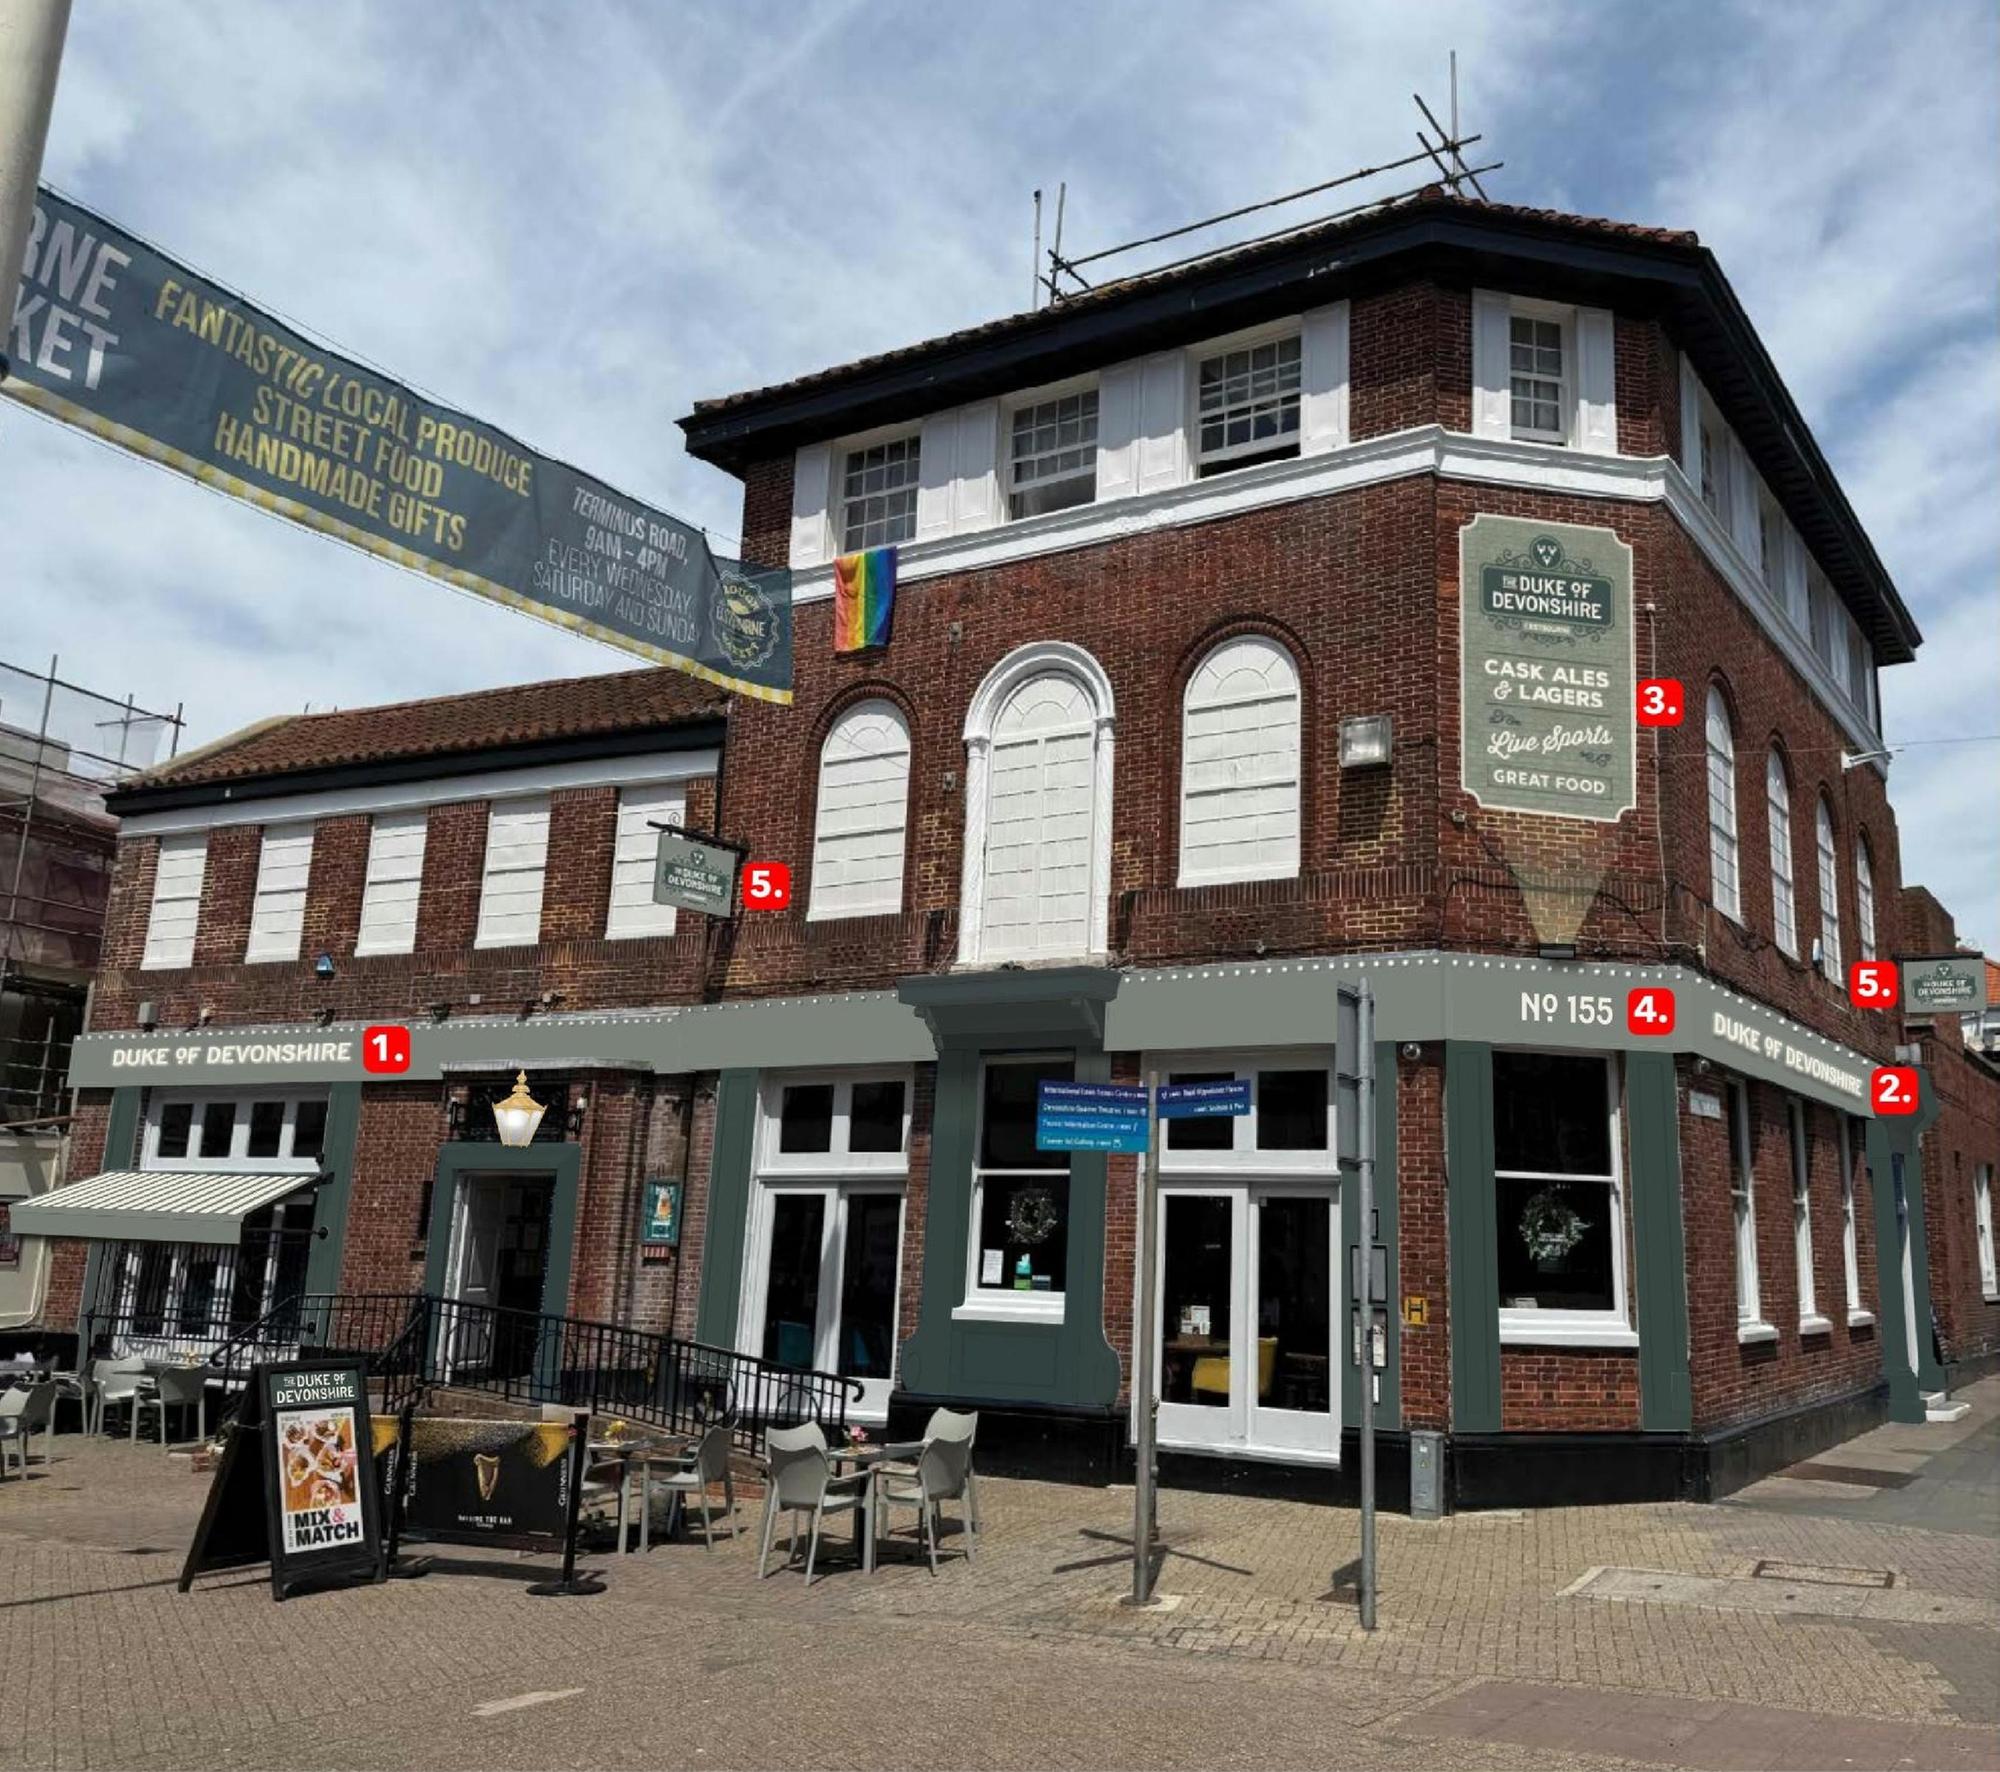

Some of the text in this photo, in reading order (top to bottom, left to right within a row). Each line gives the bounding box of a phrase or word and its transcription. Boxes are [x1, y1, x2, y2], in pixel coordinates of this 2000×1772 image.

[154, 279, 533, 498] FANTASTIC LOCAL PRODUCE
[253, 386, 443, 498] STREET FOOD
[214, 411, 467, 550] HANDMADE GIFTS
[572, 487, 645, 540] TERMINUS
[550, 539, 599, 579] EVERY
[585, 527, 621, 560] 9AM
[637, 547, 668, 579] 4PM
[534, 561, 698, 643] SATURDAY AND SUNDA
[1519, 576, 1566, 597] DUKE
[1571, 582, 1592, 599] OF
[1492, 591, 1603, 619] DEVONSHIRE
[1484, 659, 1610, 688] CASK ALES
[1493, 680, 1603, 708] & LAGERS
[1487, 725, 1613, 760] Live Sports
[1493, 769, 1606, 794] GREAT FOOD
[1568, 996, 1613, 1025] 155
[112, 1042, 352, 1067] DUKE OF DEVONSHIRE
[1713, 1011, 1863, 1097] DUKE OF DEVONSHIRE
[296, 1373, 331, 1387] DUKE
[333, 1372, 347, 1385] OF
[276, 1385, 355, 1404] DEVONSHIRE
[295, 1507, 345, 1528] MIX &
[295, 1521, 359, 1547] MATCH
